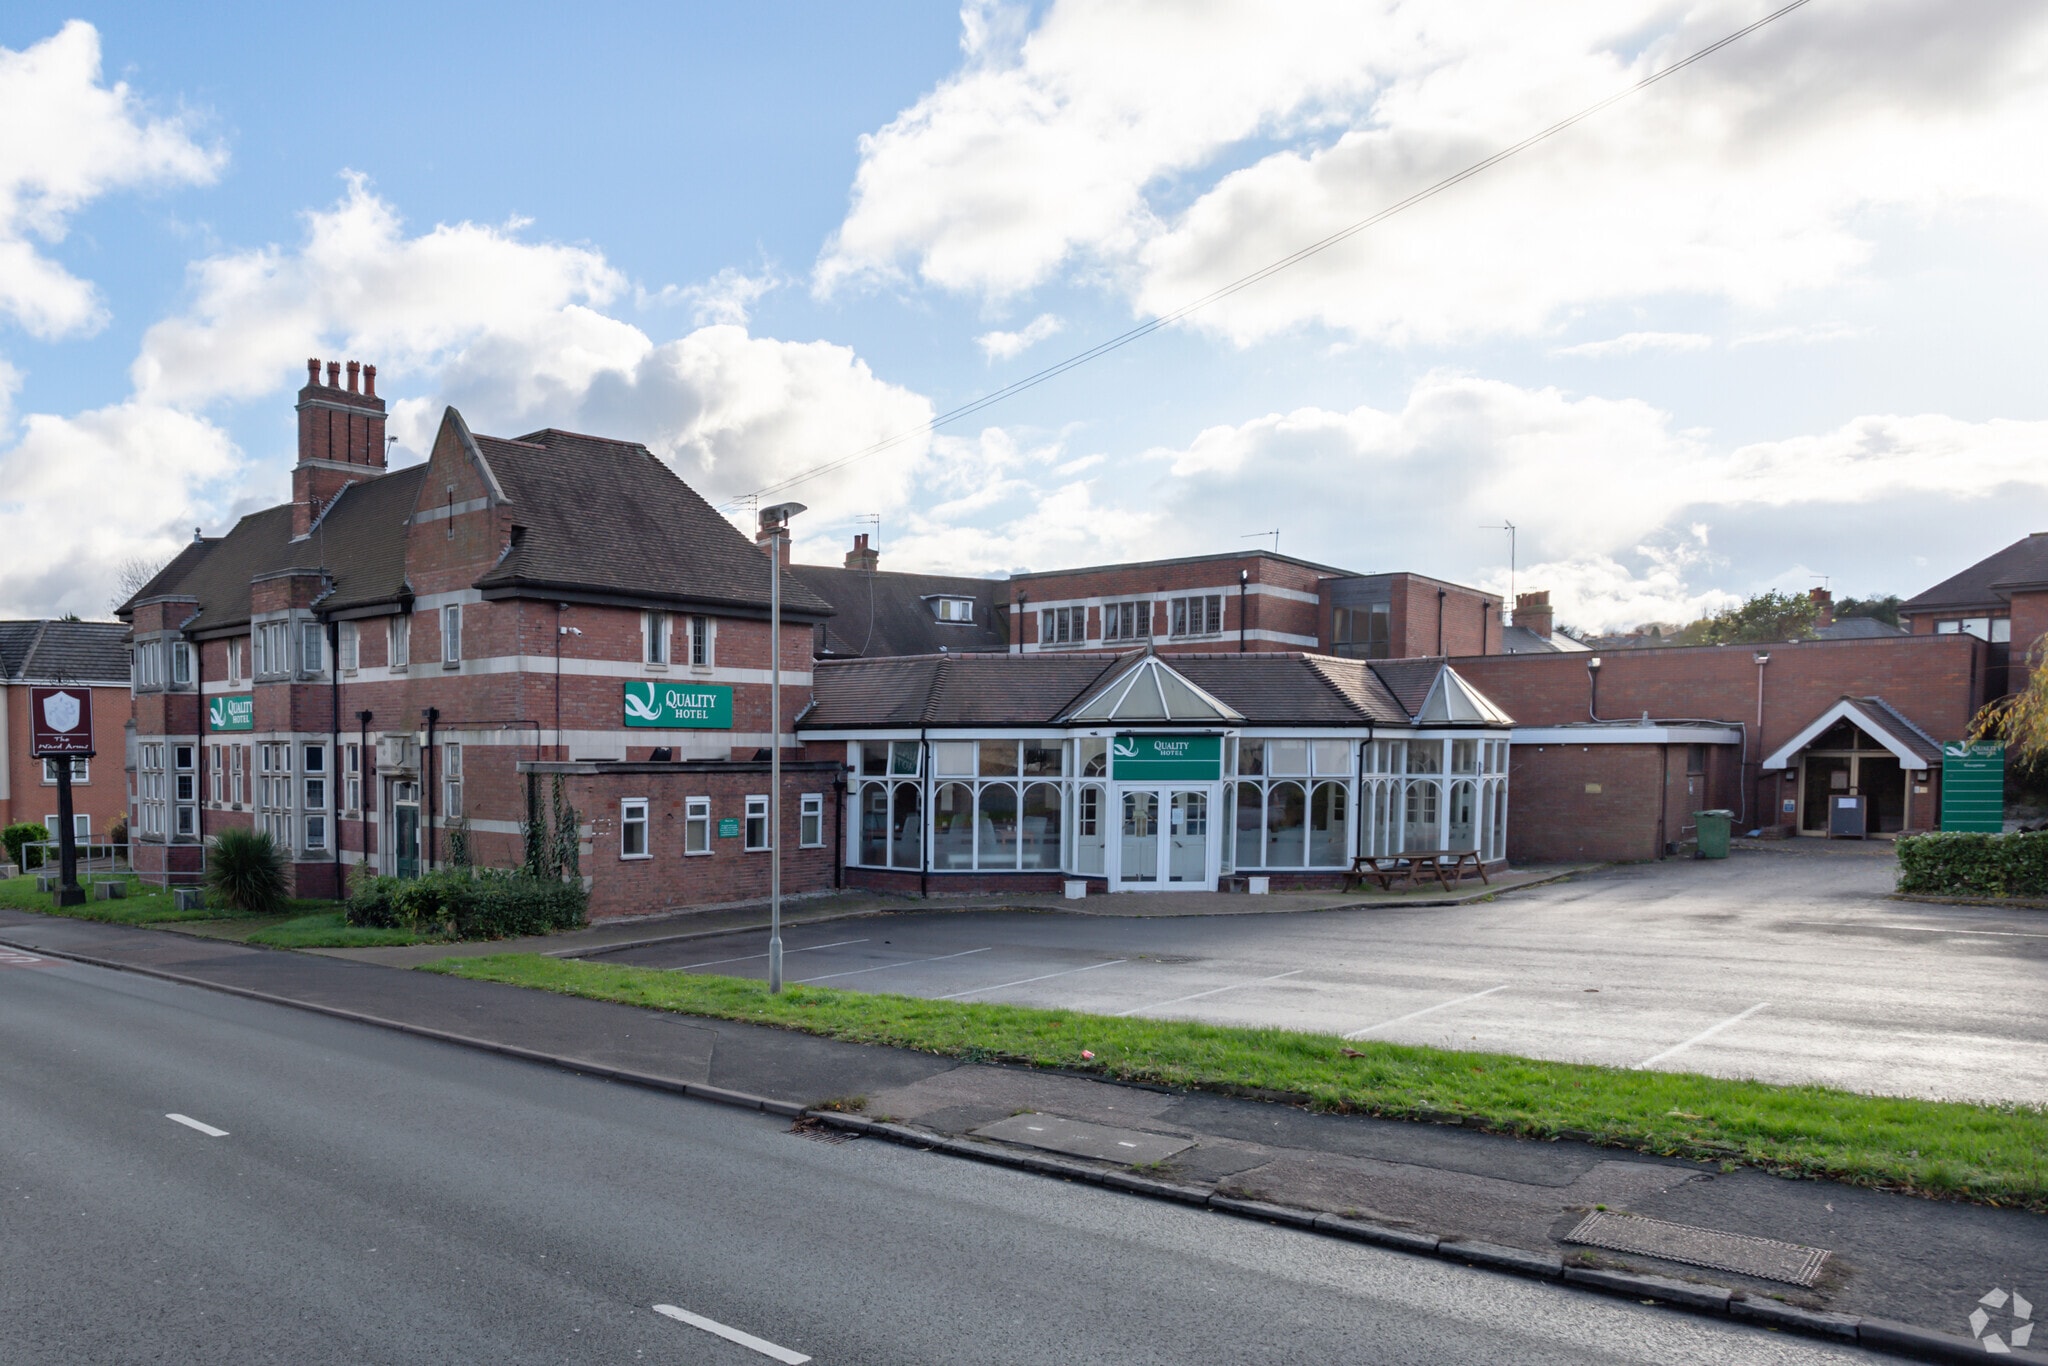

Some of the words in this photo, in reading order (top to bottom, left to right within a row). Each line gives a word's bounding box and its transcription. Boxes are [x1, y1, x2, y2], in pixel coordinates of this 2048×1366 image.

[666, 689, 717, 709] QUALITY
[232, 714, 250, 724] HOTEL
[675, 709, 709, 719] HOTEL
[1154, 740, 1189, 751] QUALITY
